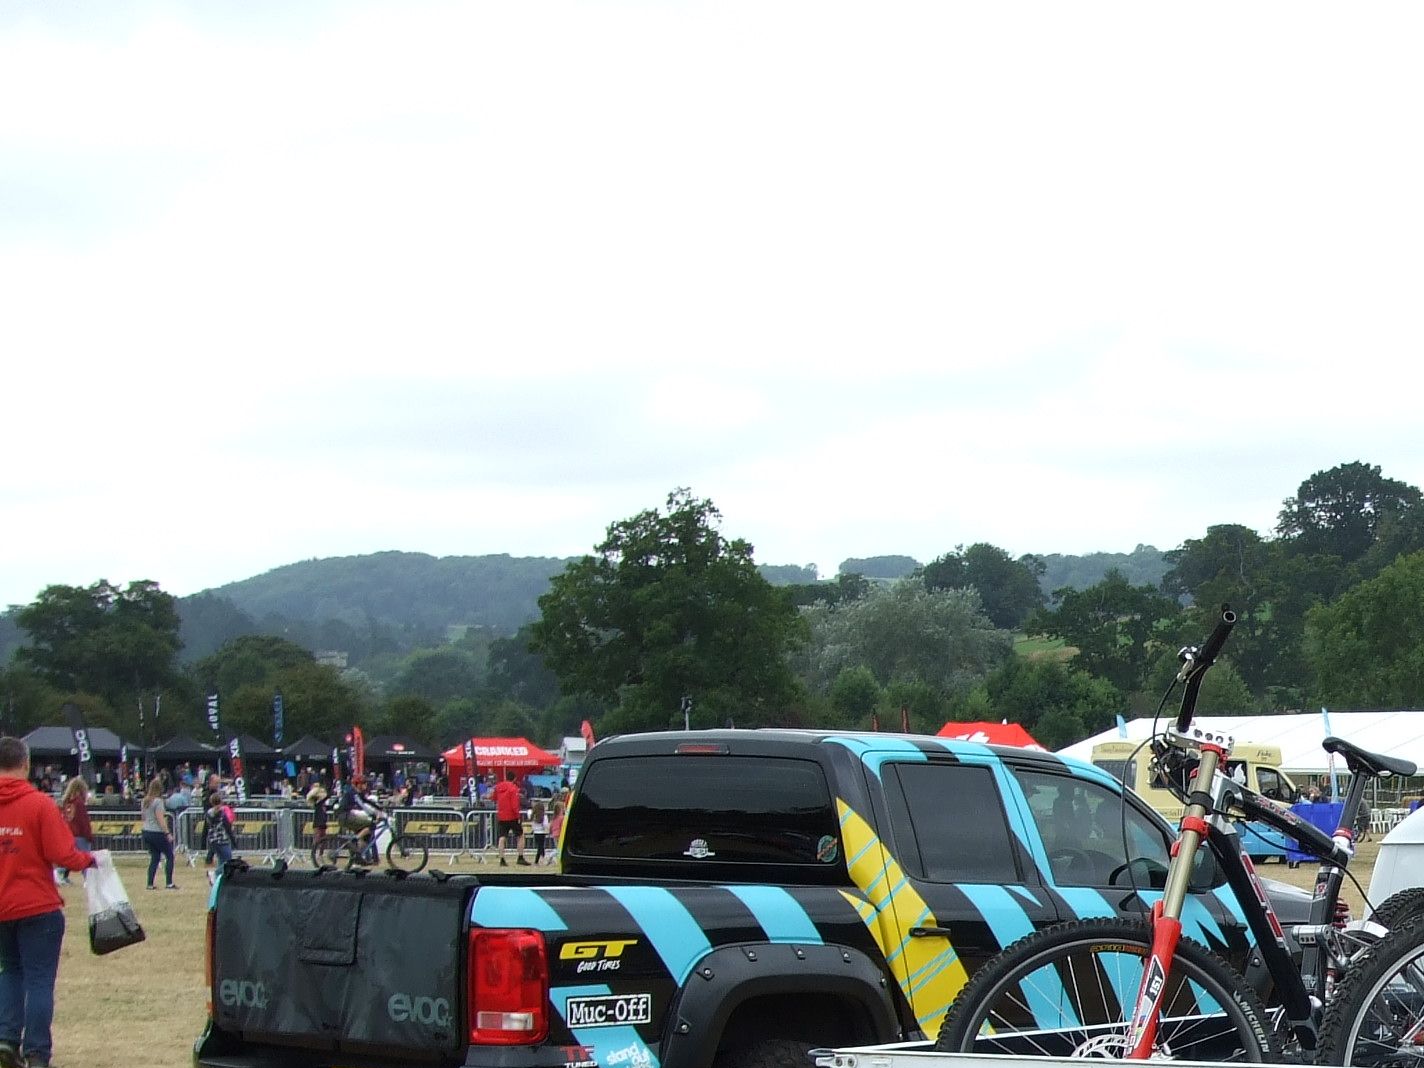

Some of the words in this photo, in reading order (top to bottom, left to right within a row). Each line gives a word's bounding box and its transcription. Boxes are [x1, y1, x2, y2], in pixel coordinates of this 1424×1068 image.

[560, 939, 638, 960] GT
[571, 997, 647, 1024] Muc-Off
[1238, 1001, 1270, 1053] MICHELIN
[564, 1060, 598, 1068] TUNED
[606, 1041, 639, 1065] stand
[631, 1048, 651, 1065] out
